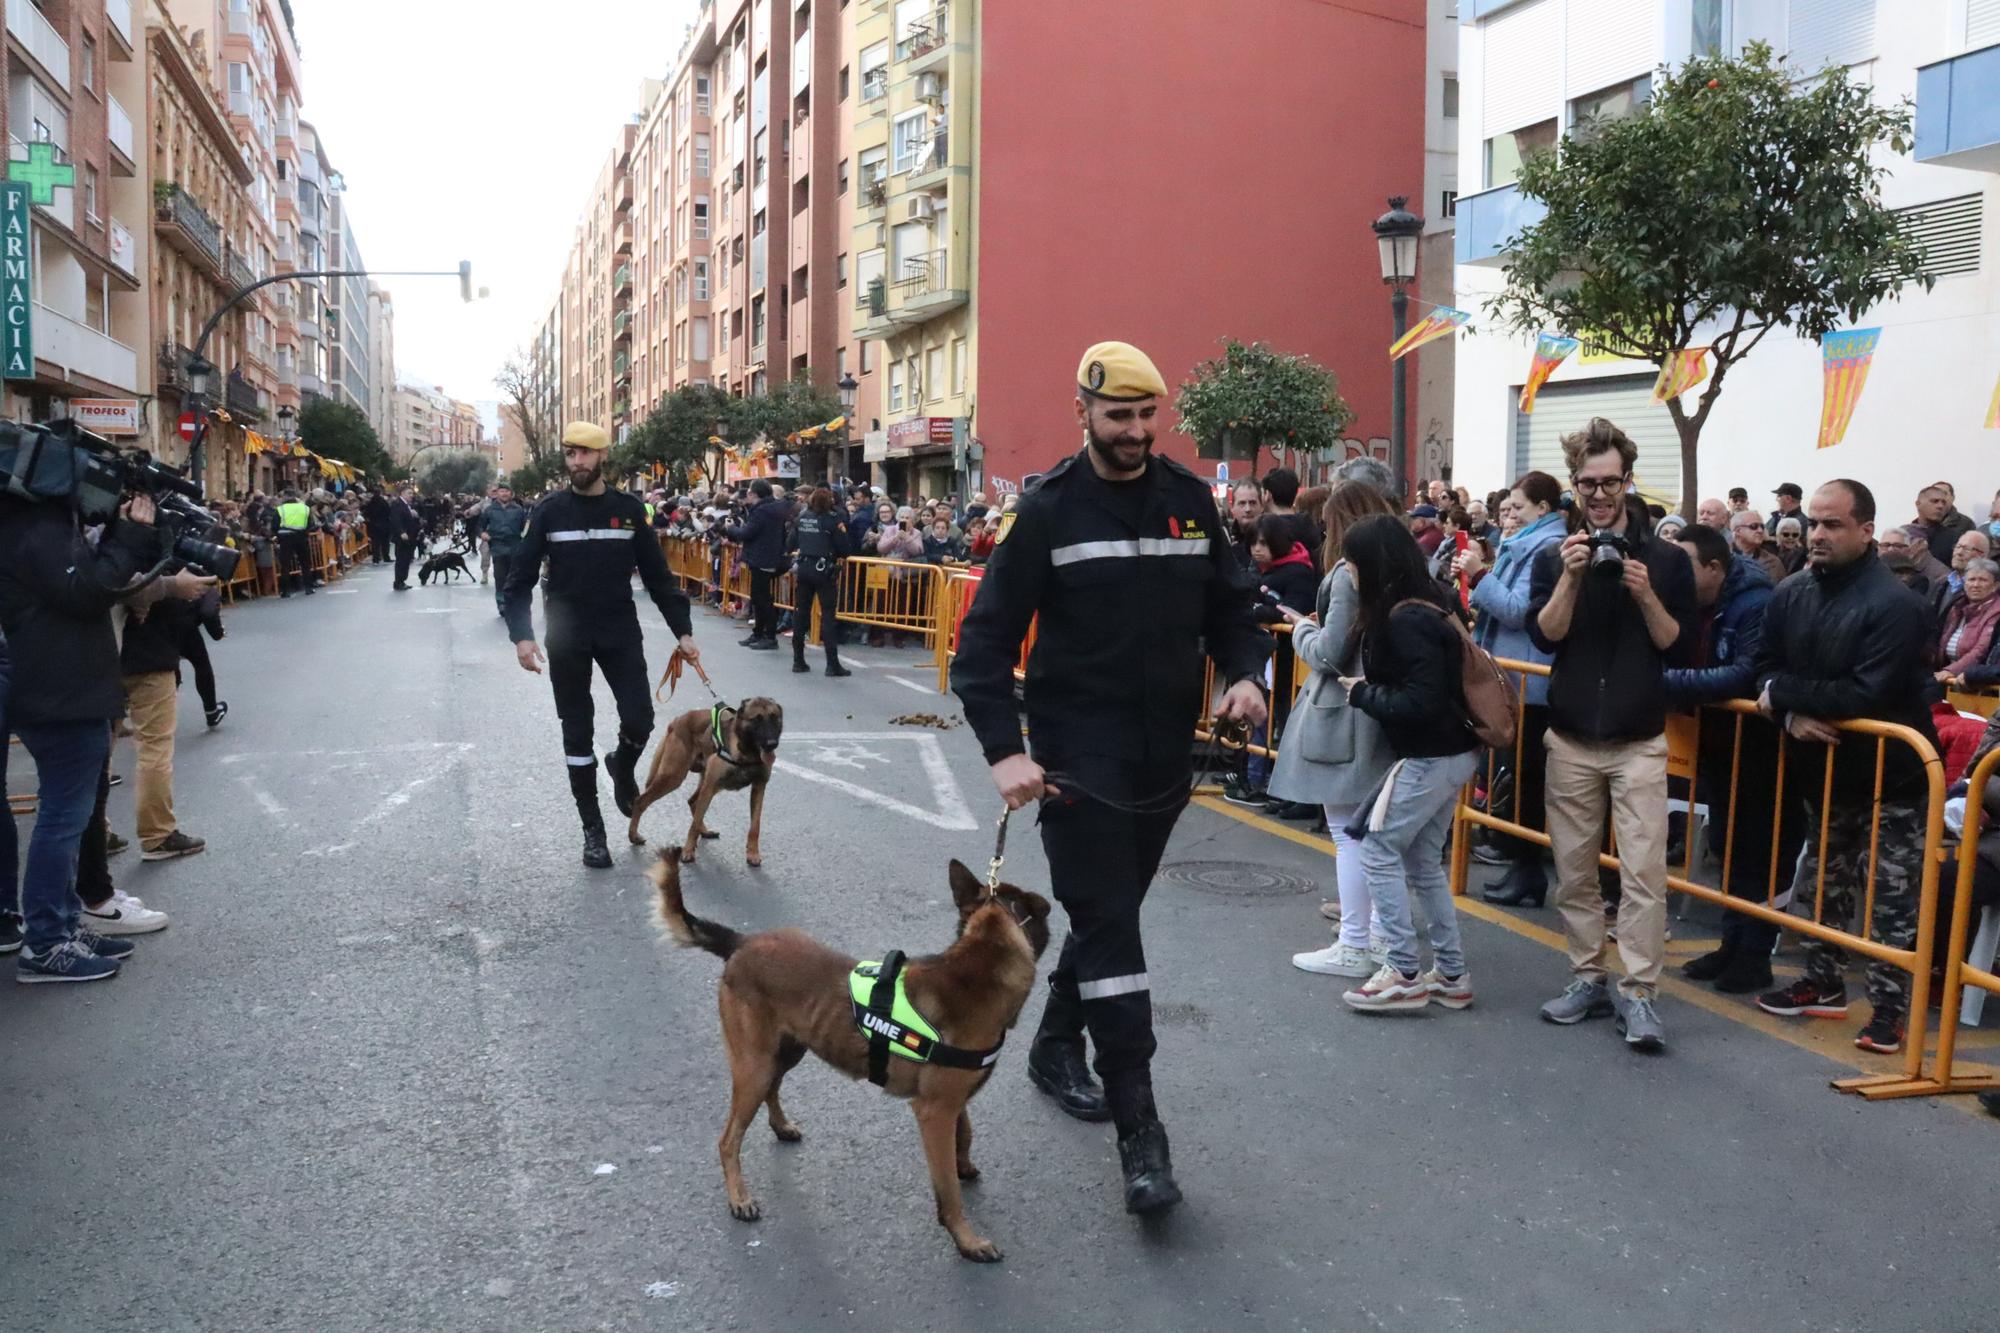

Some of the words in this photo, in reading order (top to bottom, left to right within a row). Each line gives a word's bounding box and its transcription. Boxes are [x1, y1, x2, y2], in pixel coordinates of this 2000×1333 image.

[5, 191, 26, 371] FARMACIA
[80, 407, 127, 416] TROFEOS
[863, 1013, 901, 1040] UME
